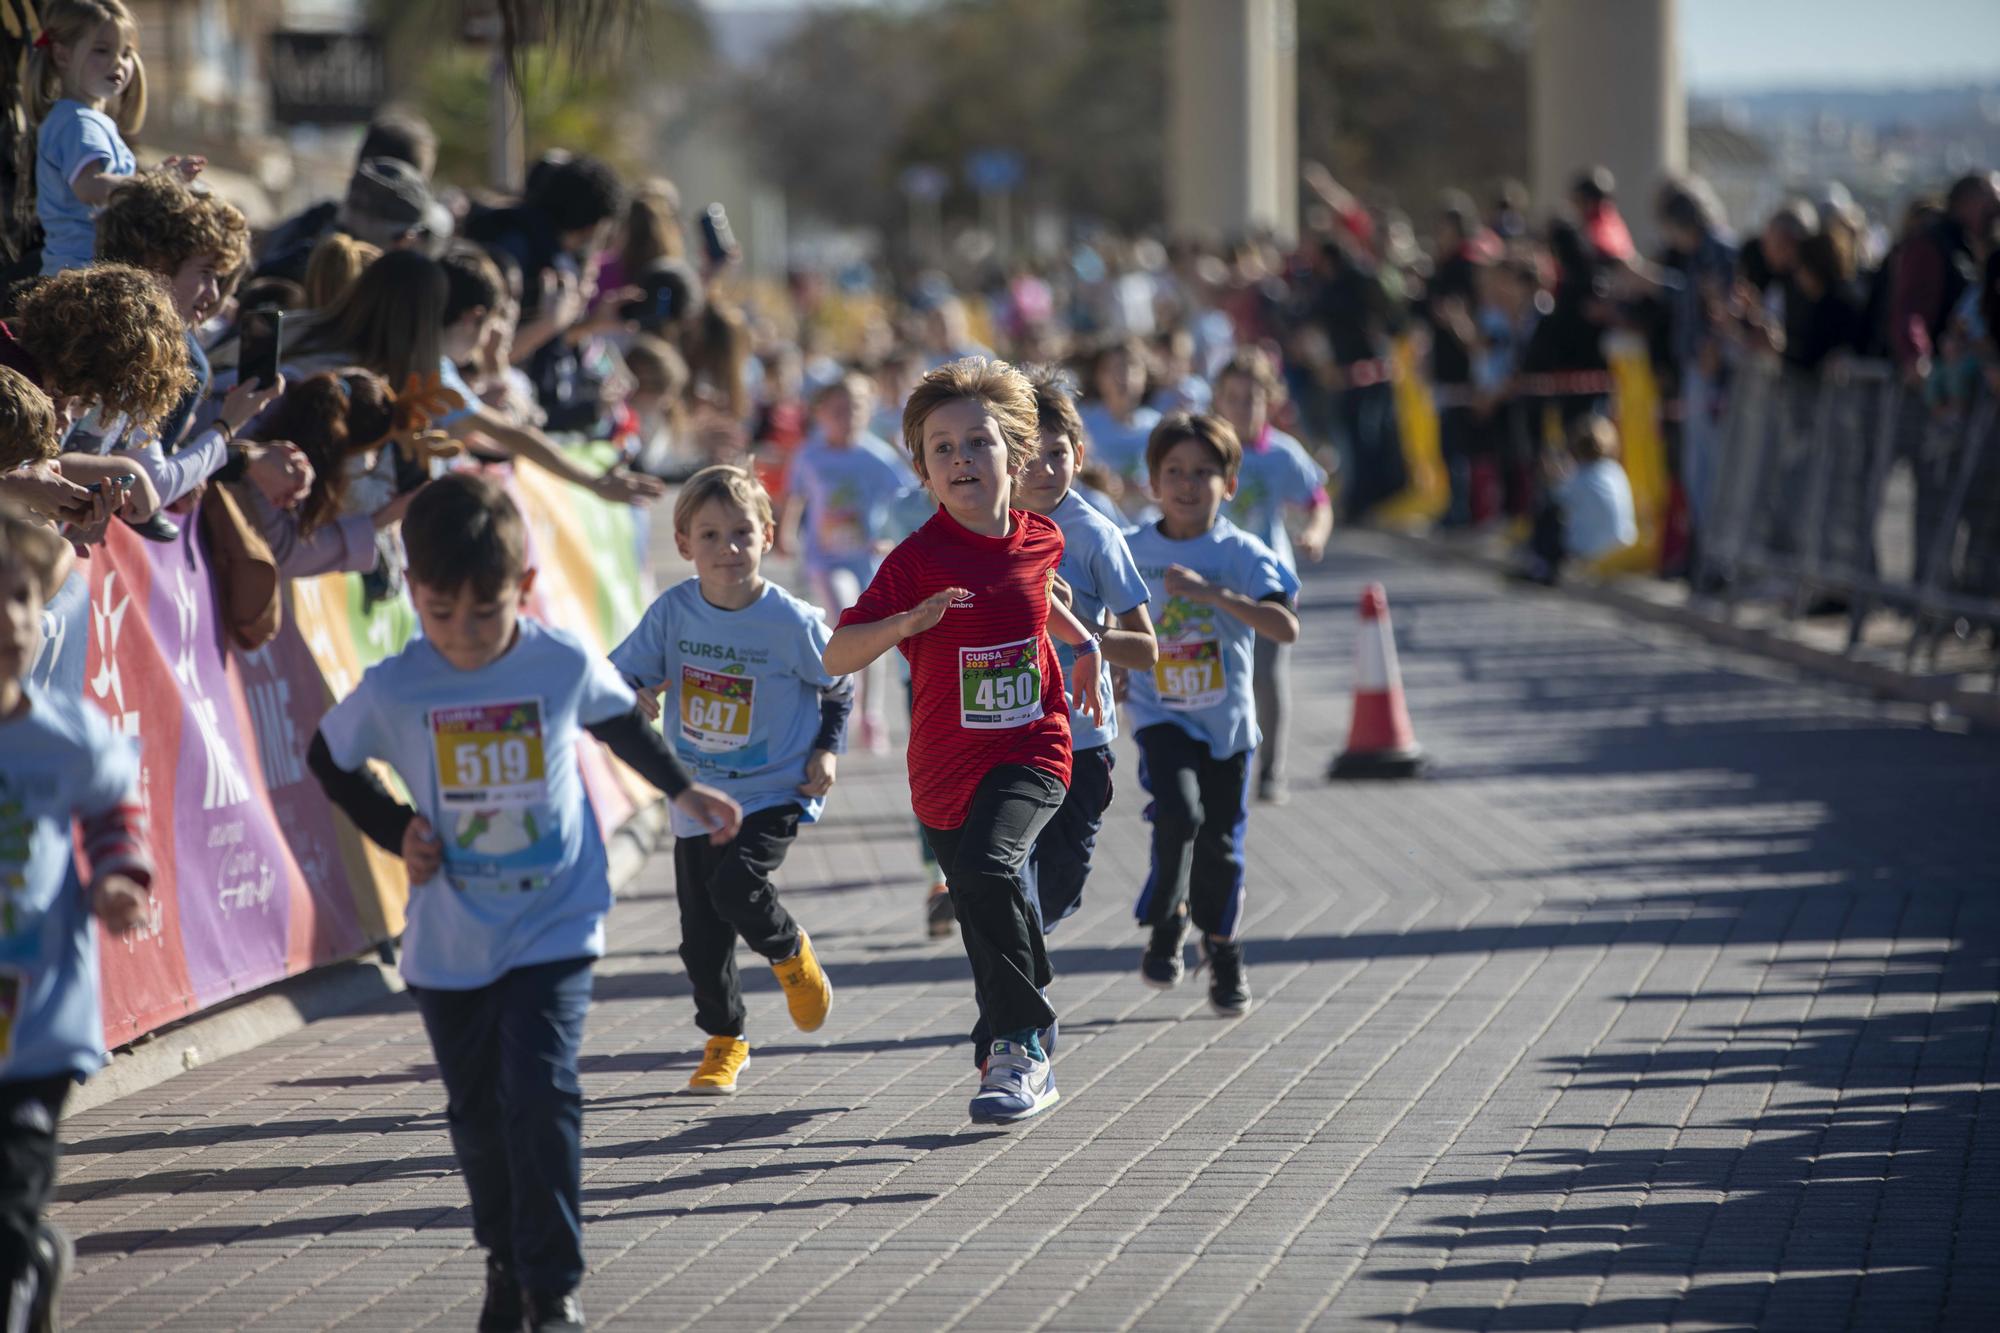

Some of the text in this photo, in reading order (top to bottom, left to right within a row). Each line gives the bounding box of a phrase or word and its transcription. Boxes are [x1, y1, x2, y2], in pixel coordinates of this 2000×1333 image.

[679, 640, 736, 661] CURSA
[965, 651, 1003, 661] CURSA
[975, 672, 1032, 710] 450
[1164, 664, 1212, 695] 567
[689, 696, 738, 732] 647
[455, 738, 528, 785] 519
